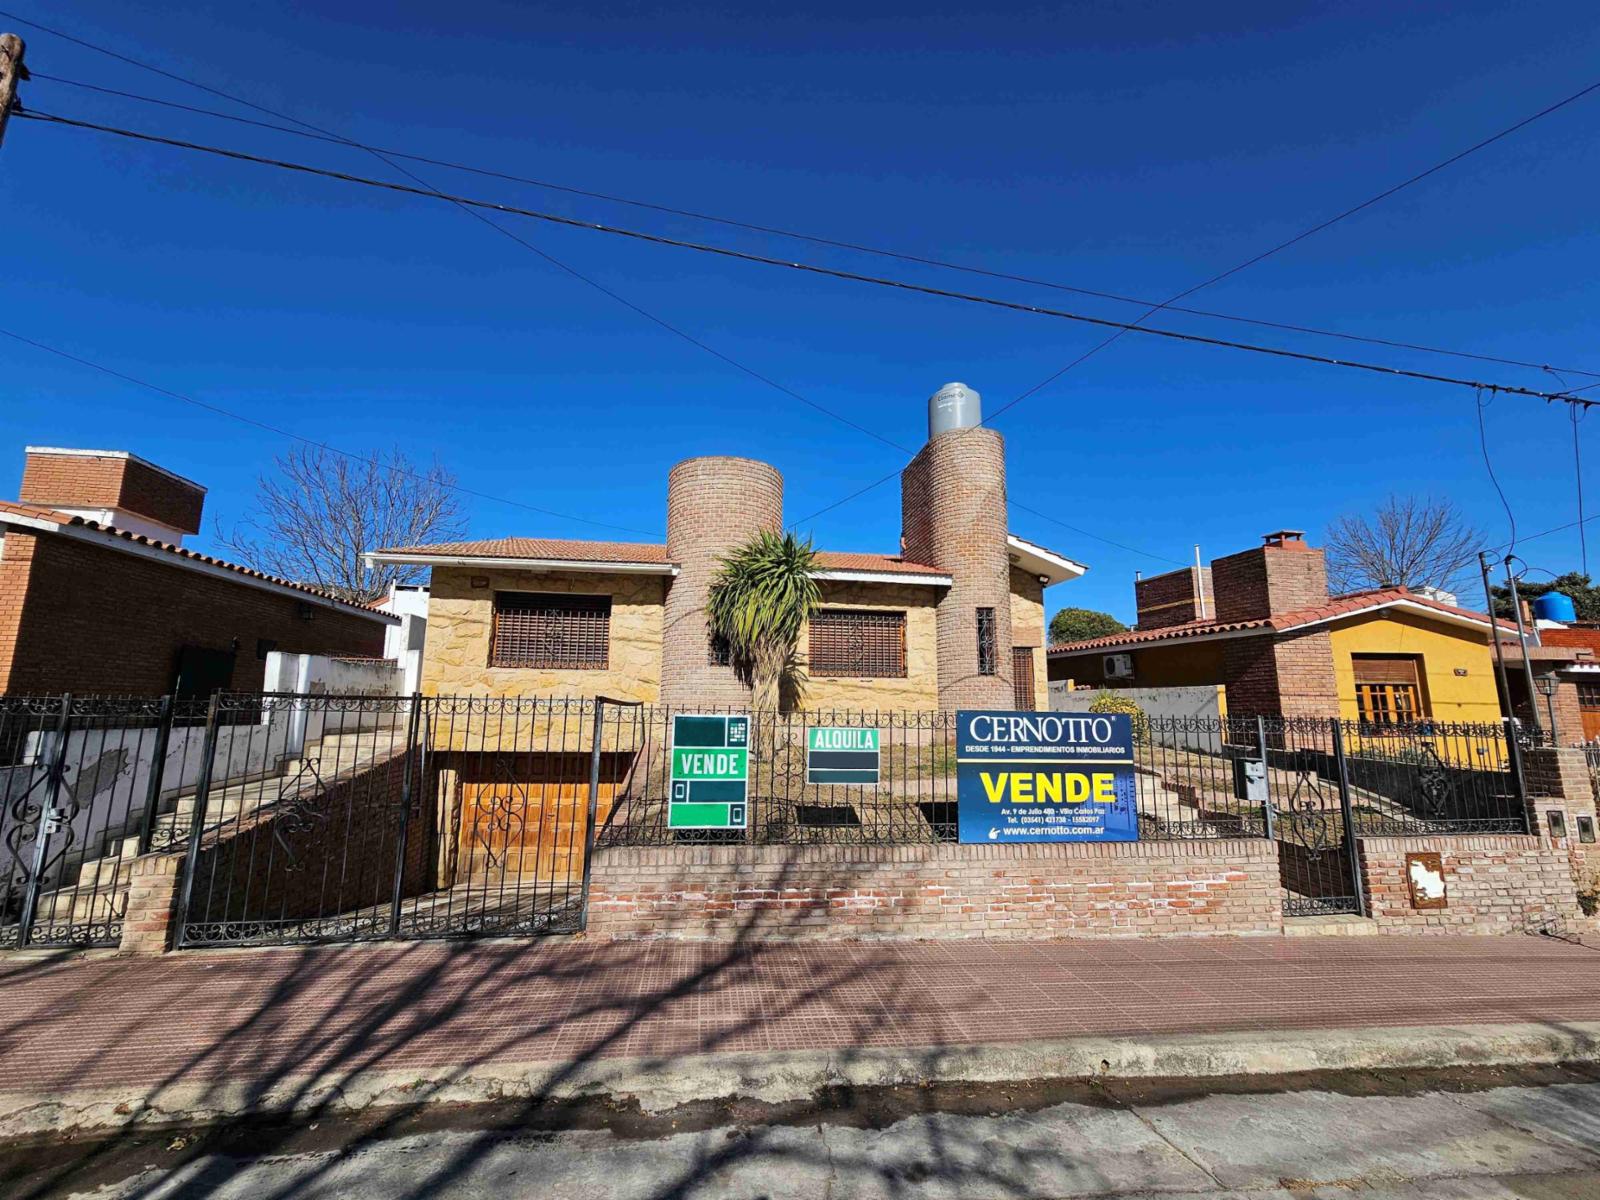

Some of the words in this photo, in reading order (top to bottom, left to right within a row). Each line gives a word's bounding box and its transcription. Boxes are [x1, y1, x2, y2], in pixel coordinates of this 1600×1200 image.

[814, 729, 874, 749] ALQUILA
[969, 715, 1112, 743] CERNOTTO
[965, 745, 990, 753] DESDE
[1010, 745, 1075, 754] EMPRENDIMIENTOS
[1076, 746, 1126, 754] INMOBILIARIOS
[681, 753, 739, 775] VENDE
[979, 772, 1117, 803] VENDE
[1028, 807, 1042, 815] Julio
[1003, 826, 1105, 835] www.cernotto.com.ar
